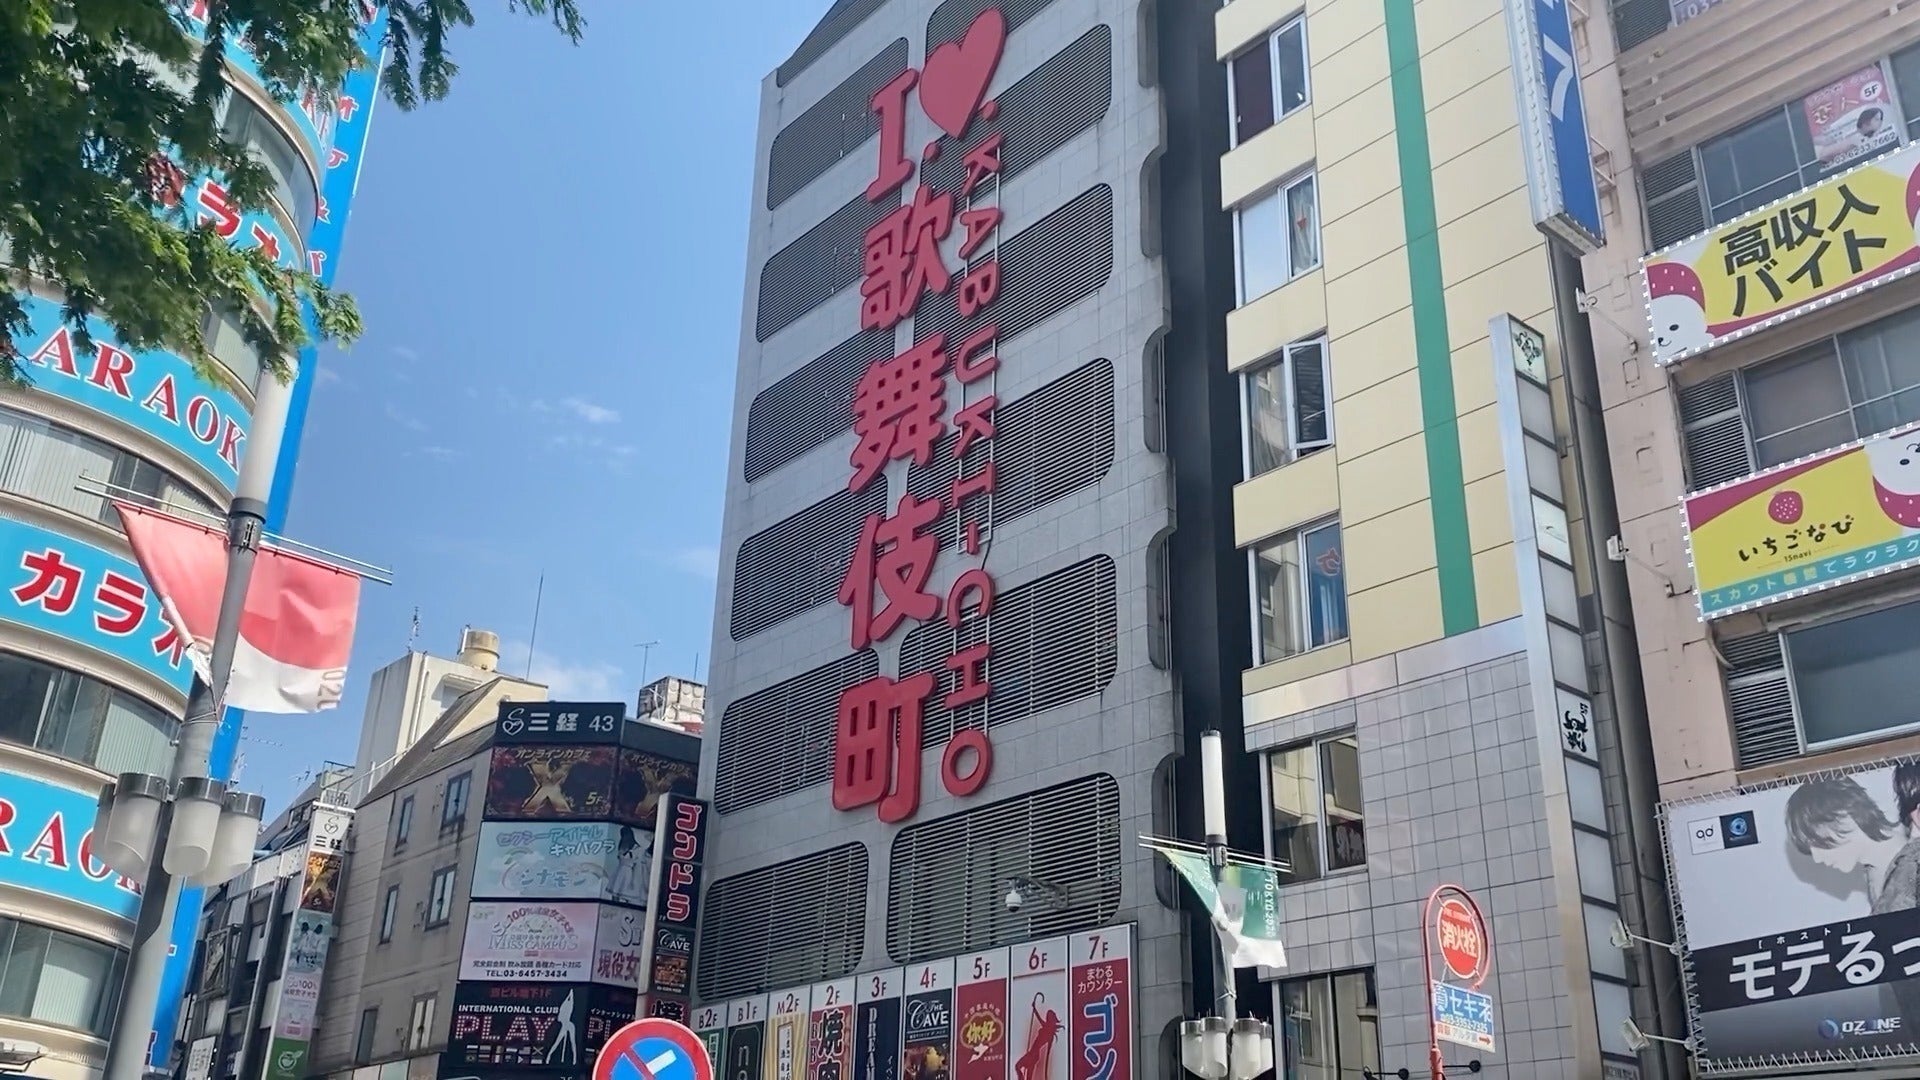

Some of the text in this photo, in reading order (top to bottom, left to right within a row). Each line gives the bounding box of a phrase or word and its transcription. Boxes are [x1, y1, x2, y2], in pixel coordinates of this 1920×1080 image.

[1864, 83, 1879, 98] 5F
[1719, 183, 1880, 276] 高収入
[1732, 229, 1888, 318] バイト
[833, 184, 955, 823] 歌舞伎町
[1738, 514, 1855, 563] いちごなび
[528, 711, 615, 733] 三経 43
[514, 748, 592, 762] オンラインカフェ
[666, 802, 703, 922] ゴンドラ
[1088, 935, 1109, 961] 7F
[1441, 918, 1478, 958] 消火栓
[972, 956, 991, 980] 5F
[1028, 946, 1048, 970] 6F
[919, 966, 937, 989] 4F
[1086, 965, 1114, 981] まわる
[825, 984, 841, 1006] 2F
[871, 976, 887, 998] 3F
[1077, 977, 1123, 994] カウンター
[458, 1004, 559, 1015] INTERNATIONAL CLUB
[737, 1001, 758, 1022] B1F
[776, 992, 800, 1015] M2F
[907, 999, 949, 1031] CAVE
[454, 1015, 555, 1041] PLAY
[698, 1008, 718, 1029] B2F
